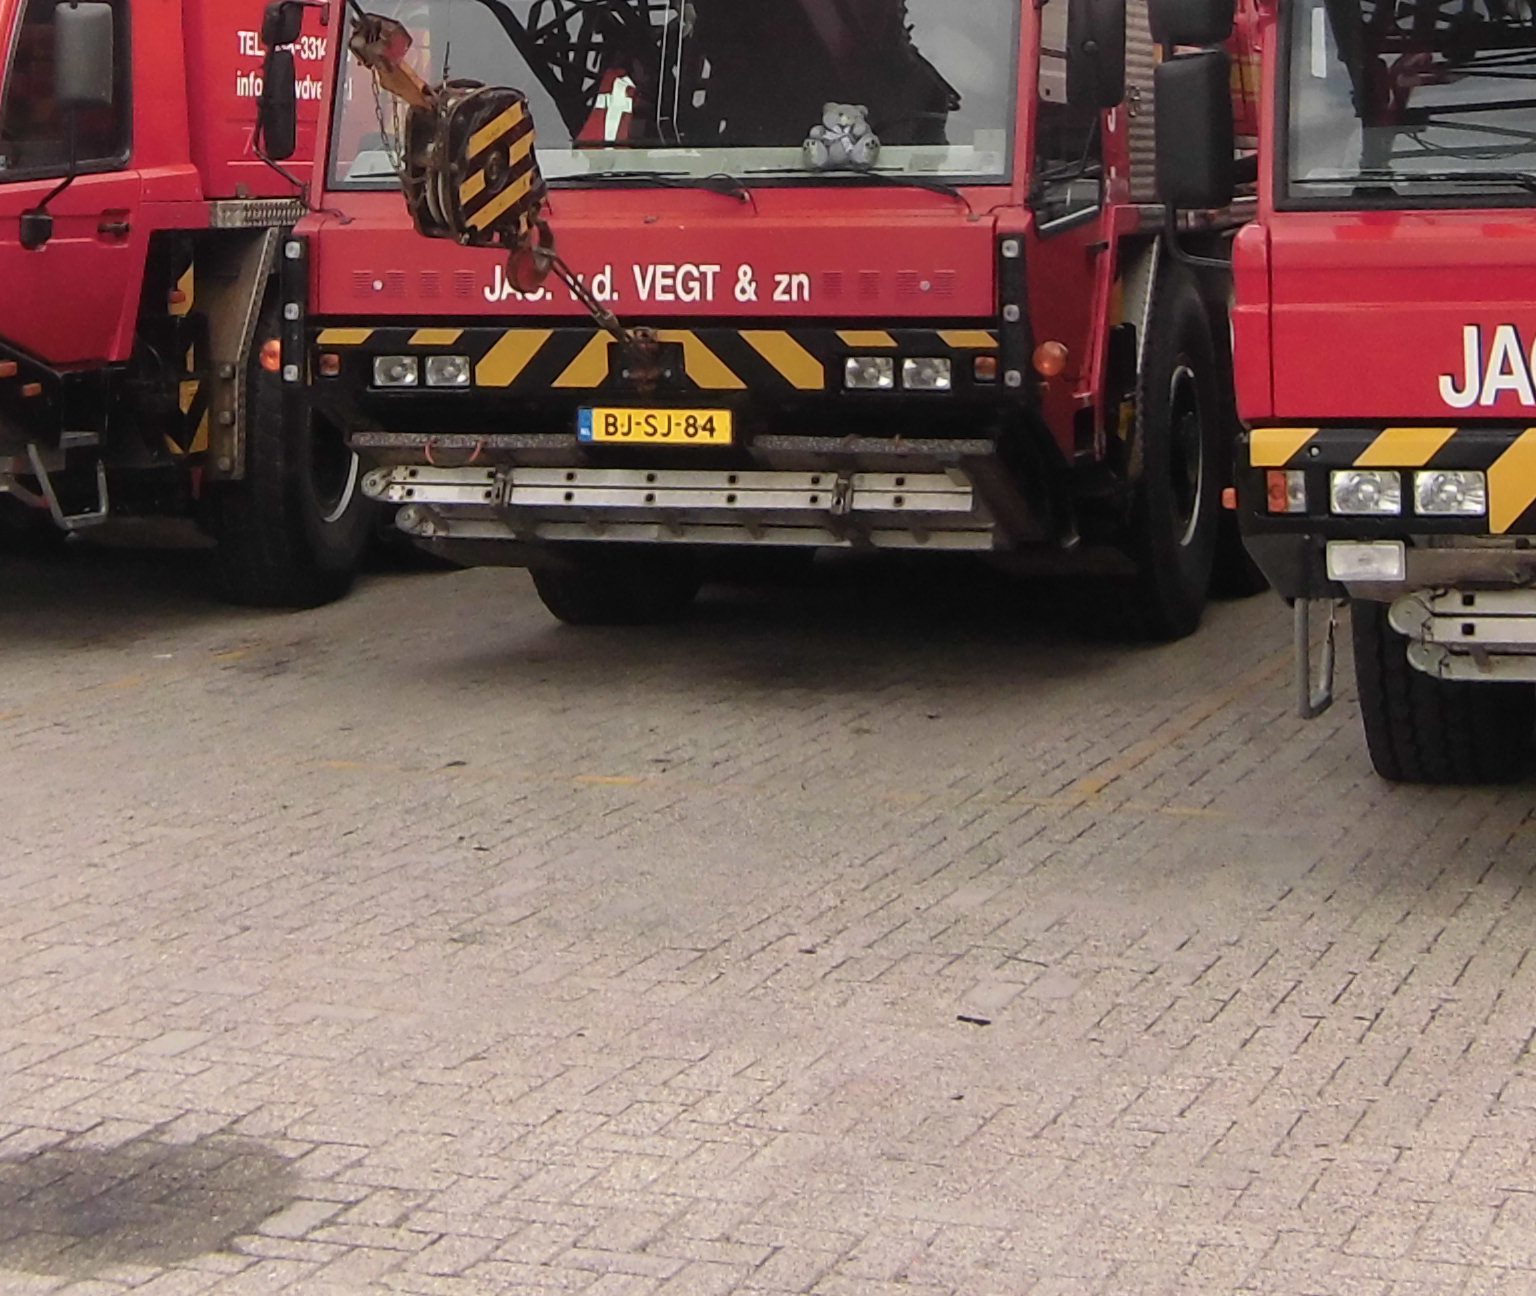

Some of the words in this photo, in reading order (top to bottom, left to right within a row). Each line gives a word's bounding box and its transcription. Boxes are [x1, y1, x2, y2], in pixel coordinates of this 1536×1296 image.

[632, 263, 721, 302] VEGT
[733, 263, 758, 302] &
[772, 272, 810, 302] zn
[604, 413, 717, 438] BJ-SJ-84
